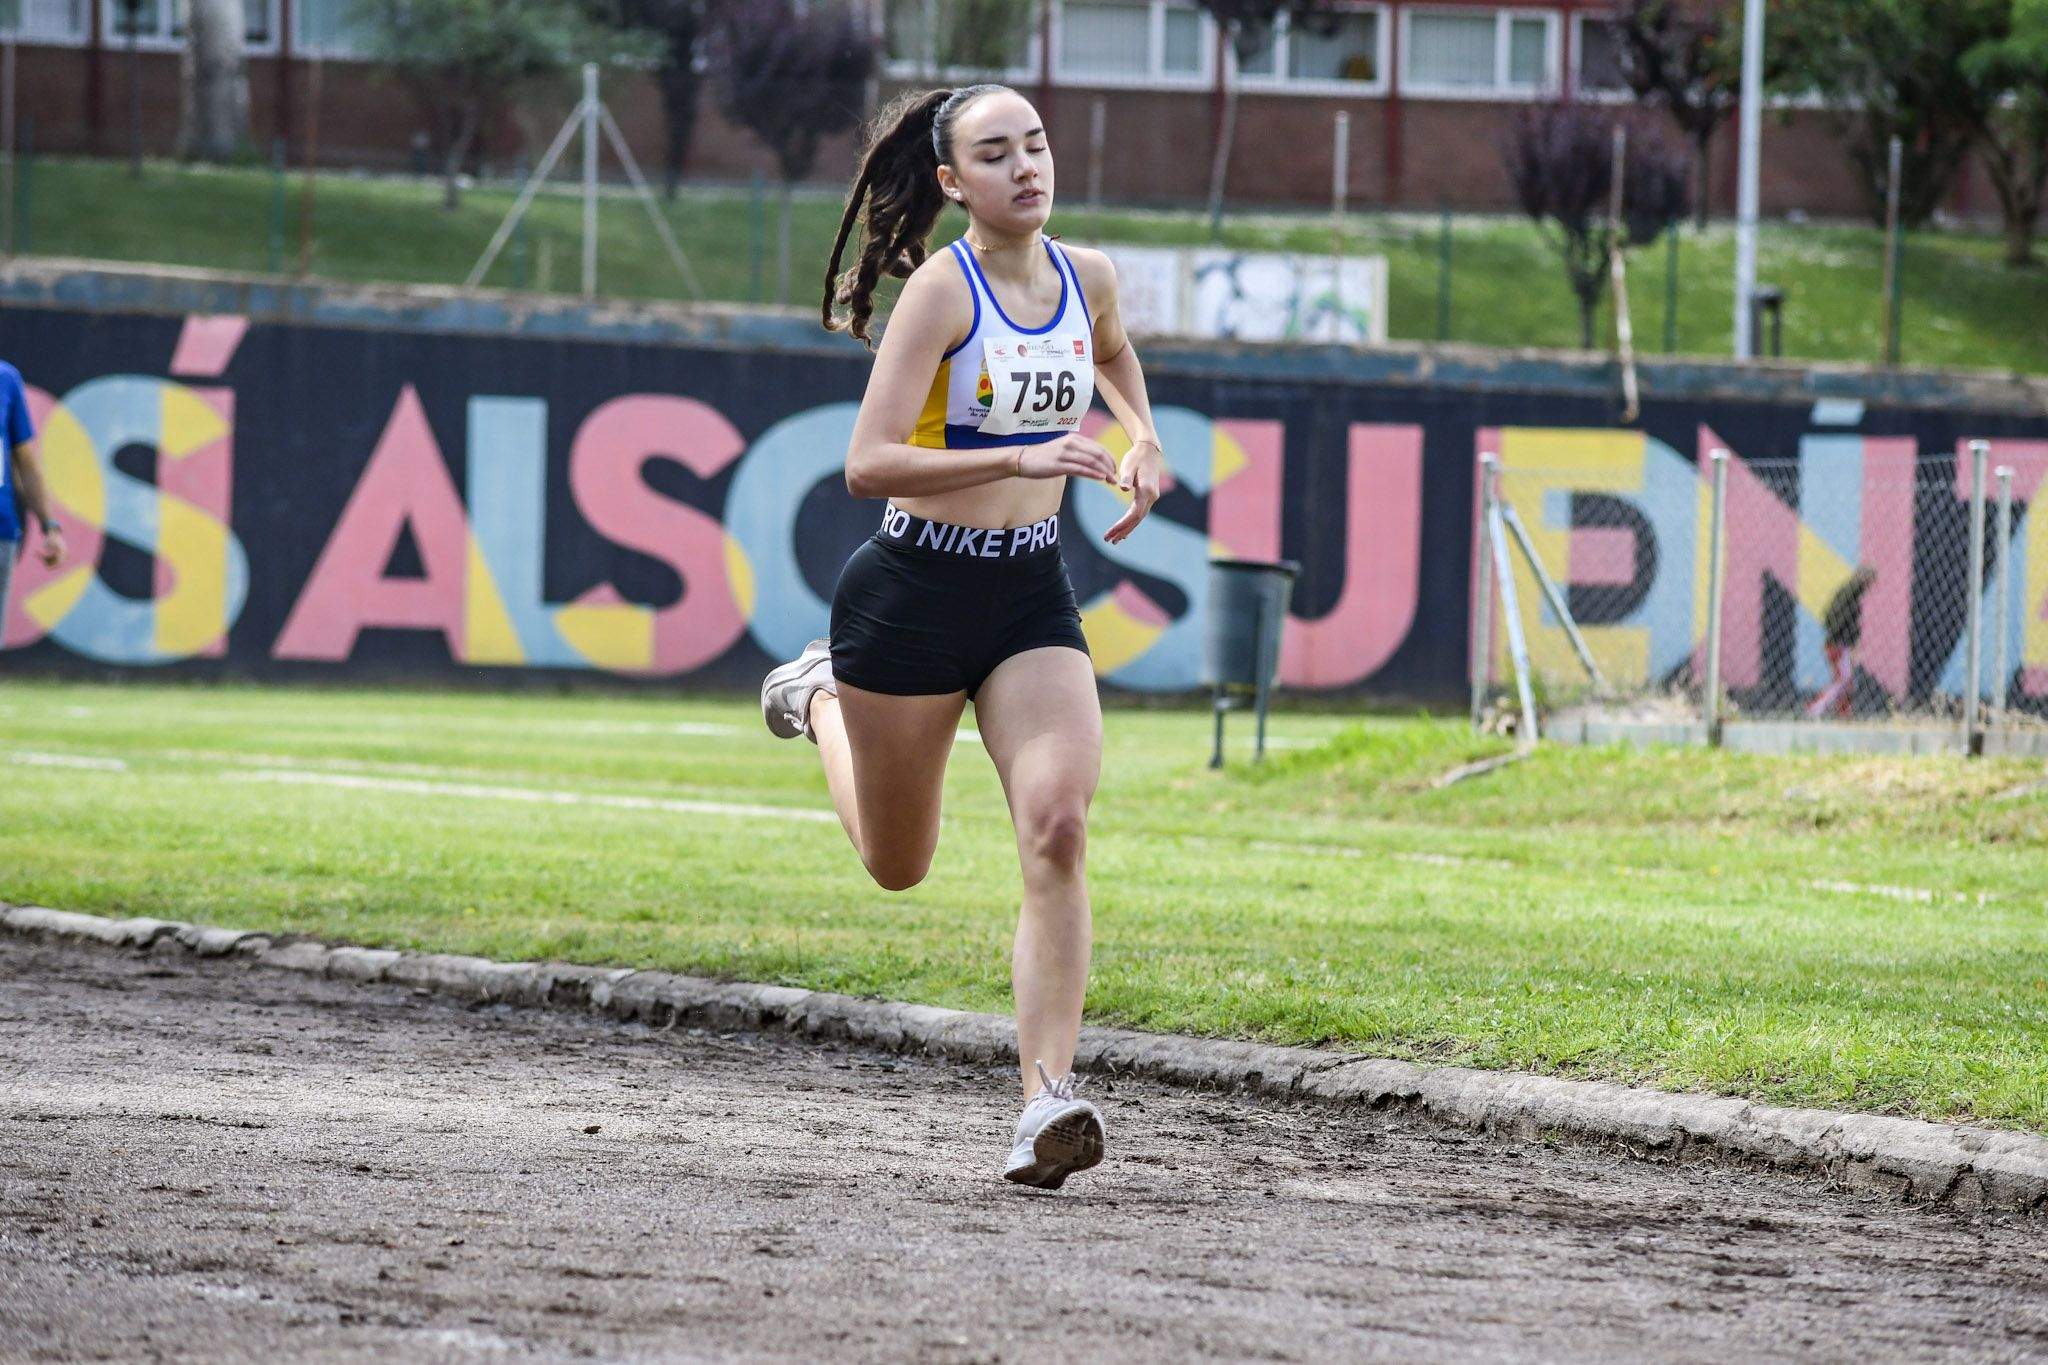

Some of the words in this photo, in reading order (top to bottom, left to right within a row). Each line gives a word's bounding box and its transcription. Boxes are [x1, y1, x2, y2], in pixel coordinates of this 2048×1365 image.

[1010, 370, 1075, 414] 756
[1056, 417, 1078, 425] 2023
[916, 520, 1006, 558] NIKE
[1008, 514, 1058, 557] PRO
